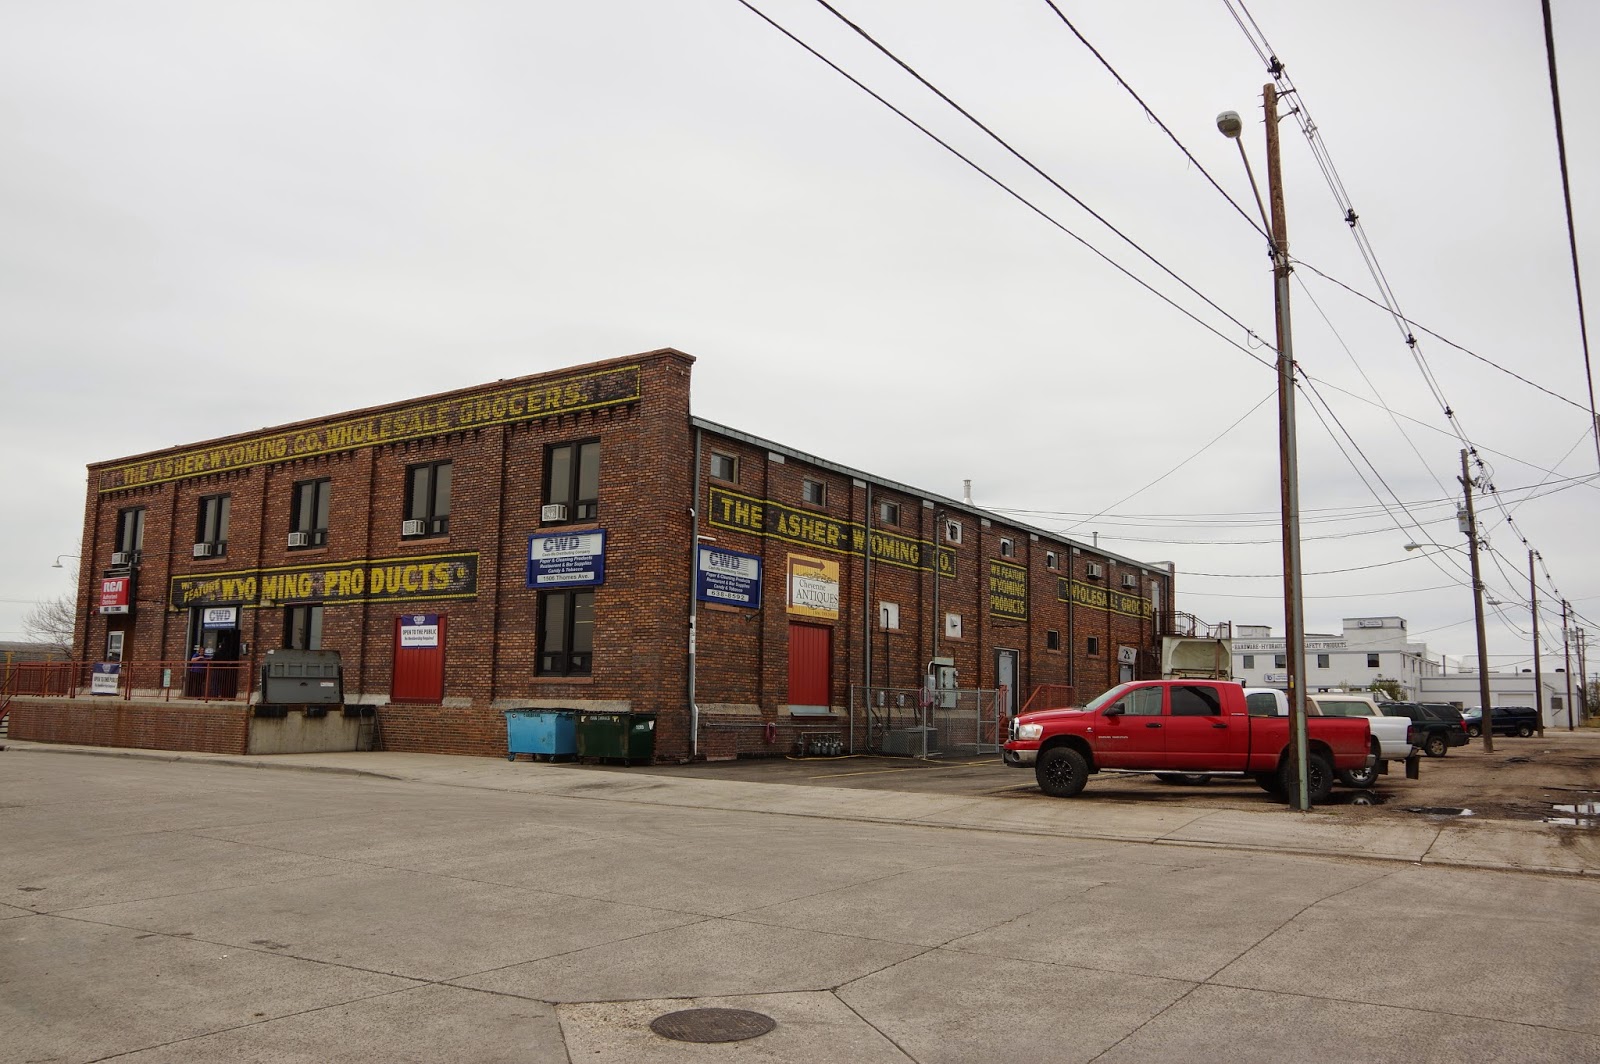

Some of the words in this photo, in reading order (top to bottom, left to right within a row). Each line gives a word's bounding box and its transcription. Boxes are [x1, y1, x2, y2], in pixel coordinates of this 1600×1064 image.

[123, 464, 149, 485] THE
[294, 431, 323, 452] CO.
[326, 402, 450, 447] WHOLESALE
[720, 497, 763, 529] THE
[543, 536, 579, 552] CWD
[709, 551, 740, 569] CWD
[184, 577, 221, 602] FEATURE
[323, 561, 450, 597] PRODUCTS
[1002, 566, 1025, 581] FEATURE
[103, 581, 123, 592] RCA
[799, 579, 827, 591] Cheyenne
[990, 577, 1025, 597] WYOMING
[711, 590, 745, 600] 638-8592
[796, 589, 838, 604] ANTIQUES
[990, 595, 1025, 614] PRODUCTS
[209, 610, 231, 621] CWD
